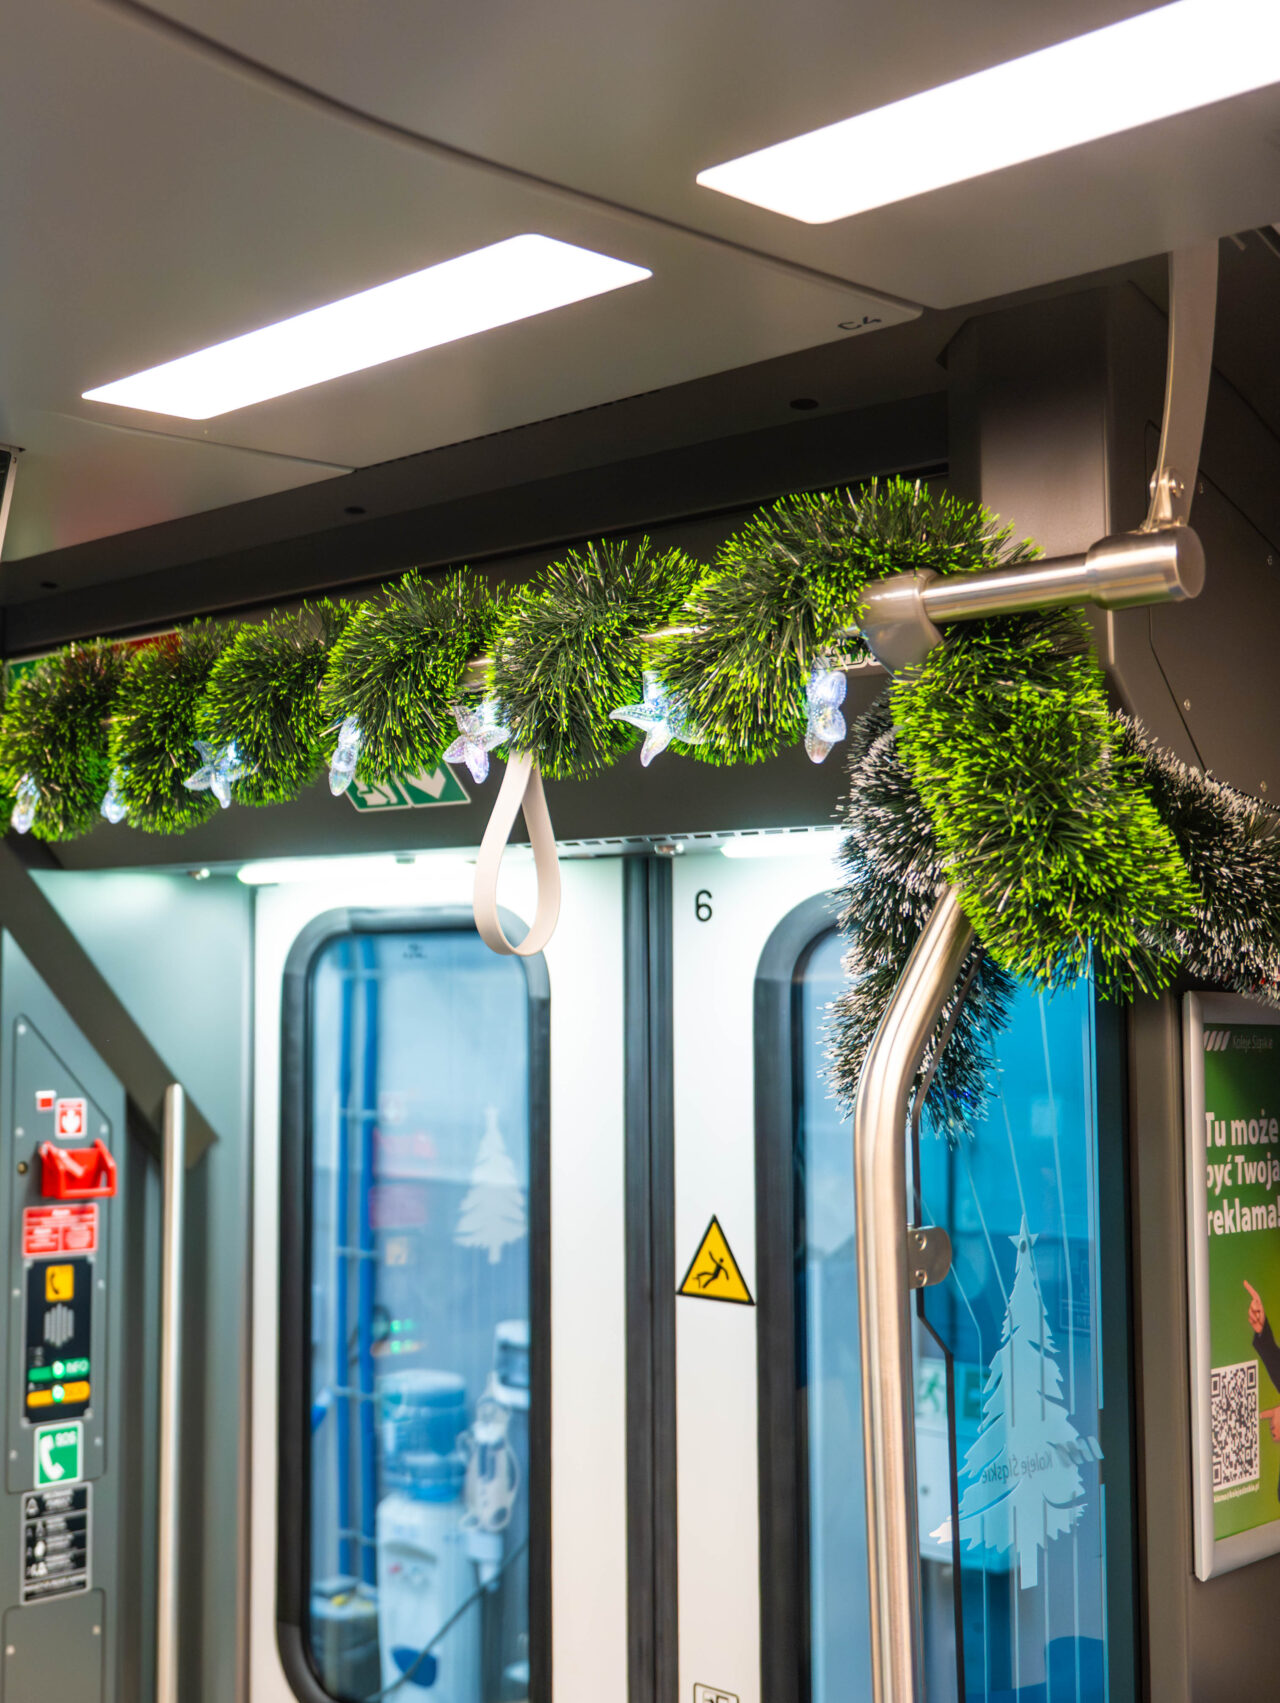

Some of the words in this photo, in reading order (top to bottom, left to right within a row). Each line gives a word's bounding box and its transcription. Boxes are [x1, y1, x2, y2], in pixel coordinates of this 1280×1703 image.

[694, 889, 713, 922] 6
[1205, 1112, 1226, 1147] Tu
[1230, 1109, 1279, 1146] może
[1234, 1152, 1280, 1191] Twoja
[1207, 1195, 1280, 1236] reklama!
